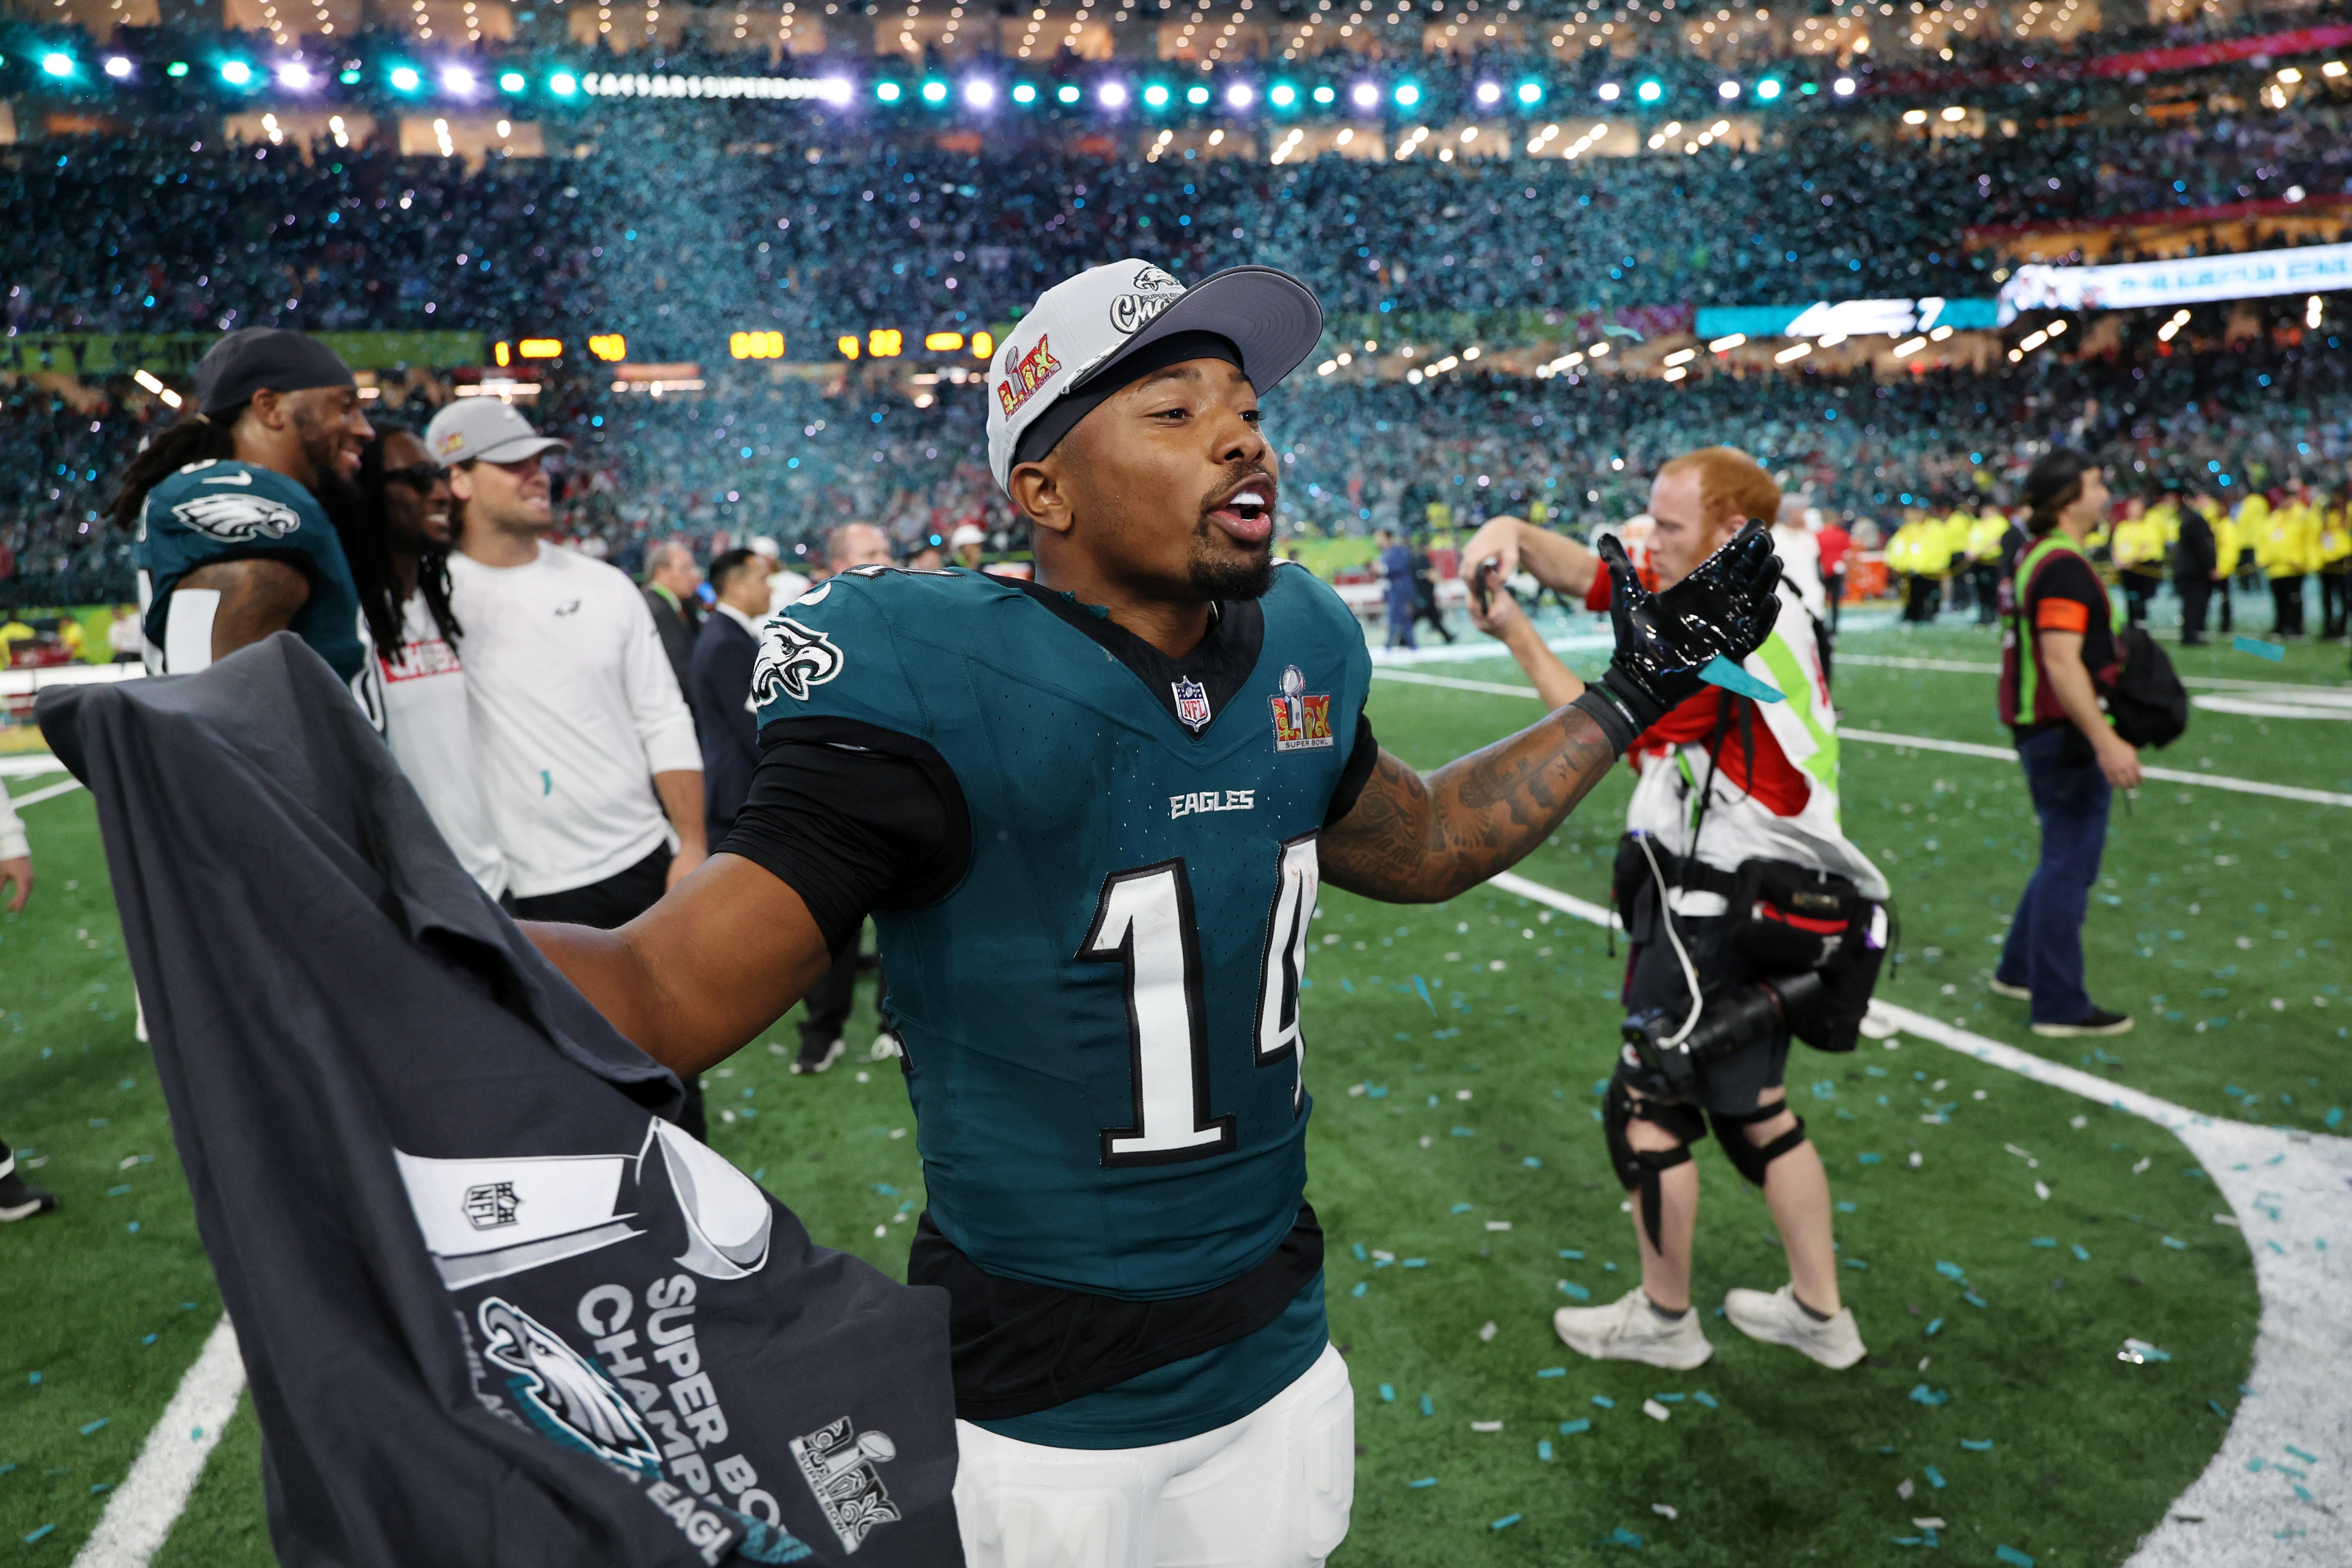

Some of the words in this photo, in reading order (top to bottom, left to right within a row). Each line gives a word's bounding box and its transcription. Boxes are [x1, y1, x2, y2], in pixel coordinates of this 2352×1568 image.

[1110, 294, 1174, 334] Cha
[1010, 391, 1033, 416] SUPER
[1034, 369, 1056, 390] BOWL
[1182, 700, 1205, 719] NFL
[1285, 740, 1310, 748] SUPER
[1169, 790, 1255, 820] EAGLES
[1074, 827, 1320, 1167] 14
[469, 1189, 494, 1224] NFL
[647, 1274, 728, 1450] SUPER
[714, 1454, 788, 1534] BO
[798, 1451, 827, 1497] SUPER
[824, 1502, 850, 1538] BOWL
